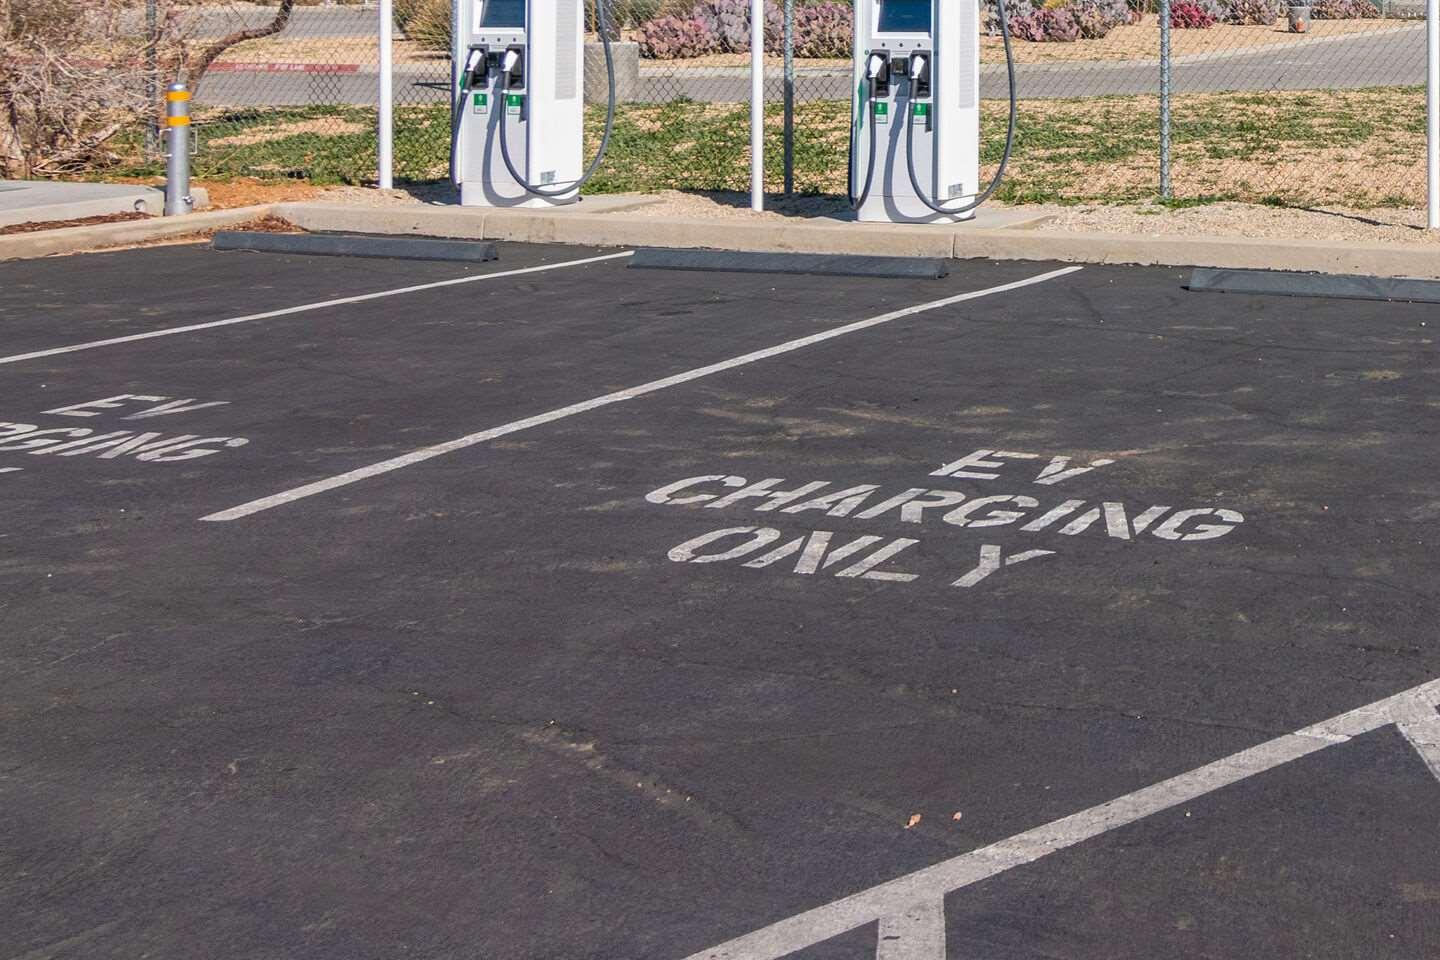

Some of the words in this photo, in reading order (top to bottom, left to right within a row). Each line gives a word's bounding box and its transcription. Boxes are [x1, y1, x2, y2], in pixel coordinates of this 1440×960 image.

[39, 393, 232, 421] EV
[929, 448, 1115, 486] EV
[644, 473, 1245, 542] CHARGING
[666, 525, 1056, 588] ONLY
